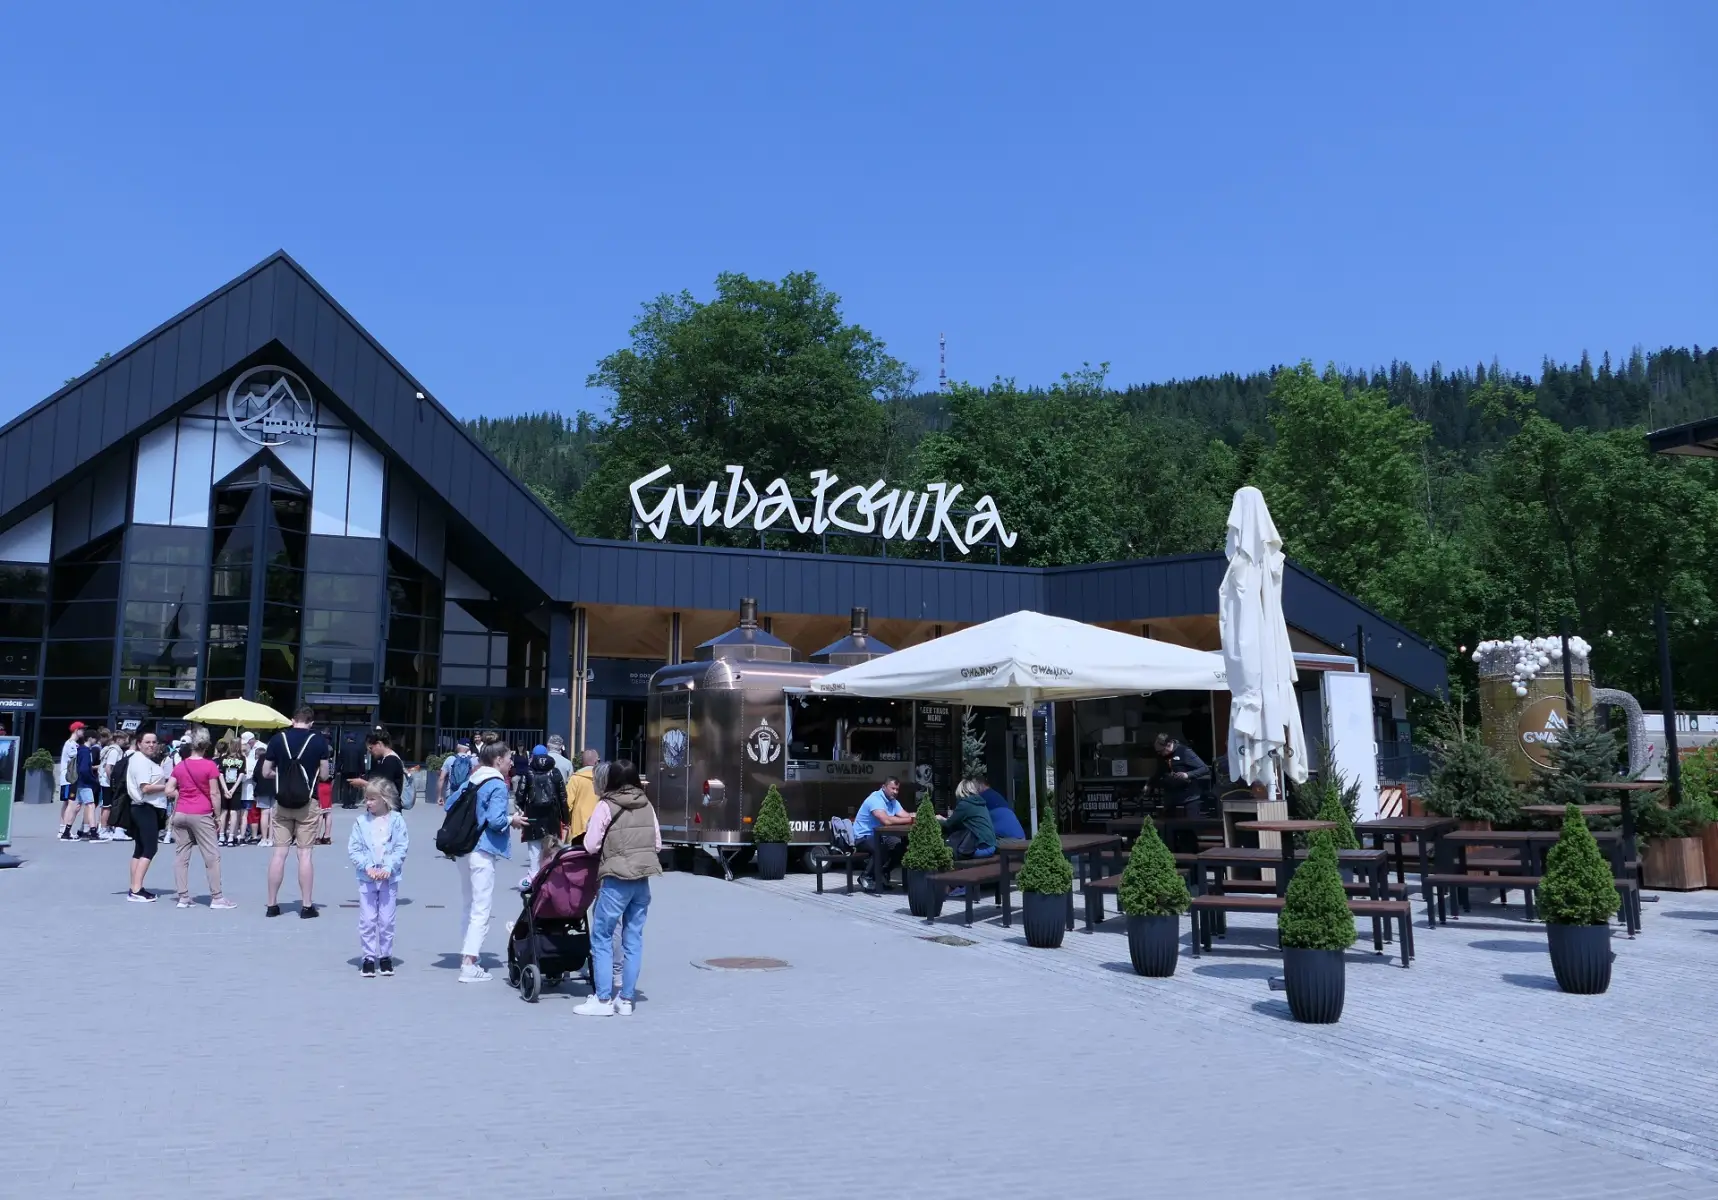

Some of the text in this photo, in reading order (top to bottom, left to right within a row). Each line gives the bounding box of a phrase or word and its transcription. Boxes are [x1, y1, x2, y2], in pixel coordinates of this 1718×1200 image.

[629, 464, 1018, 555] Gubałówka
[960, 665, 998, 678] GWARNO
[826, 763, 874, 775] GWARNO
